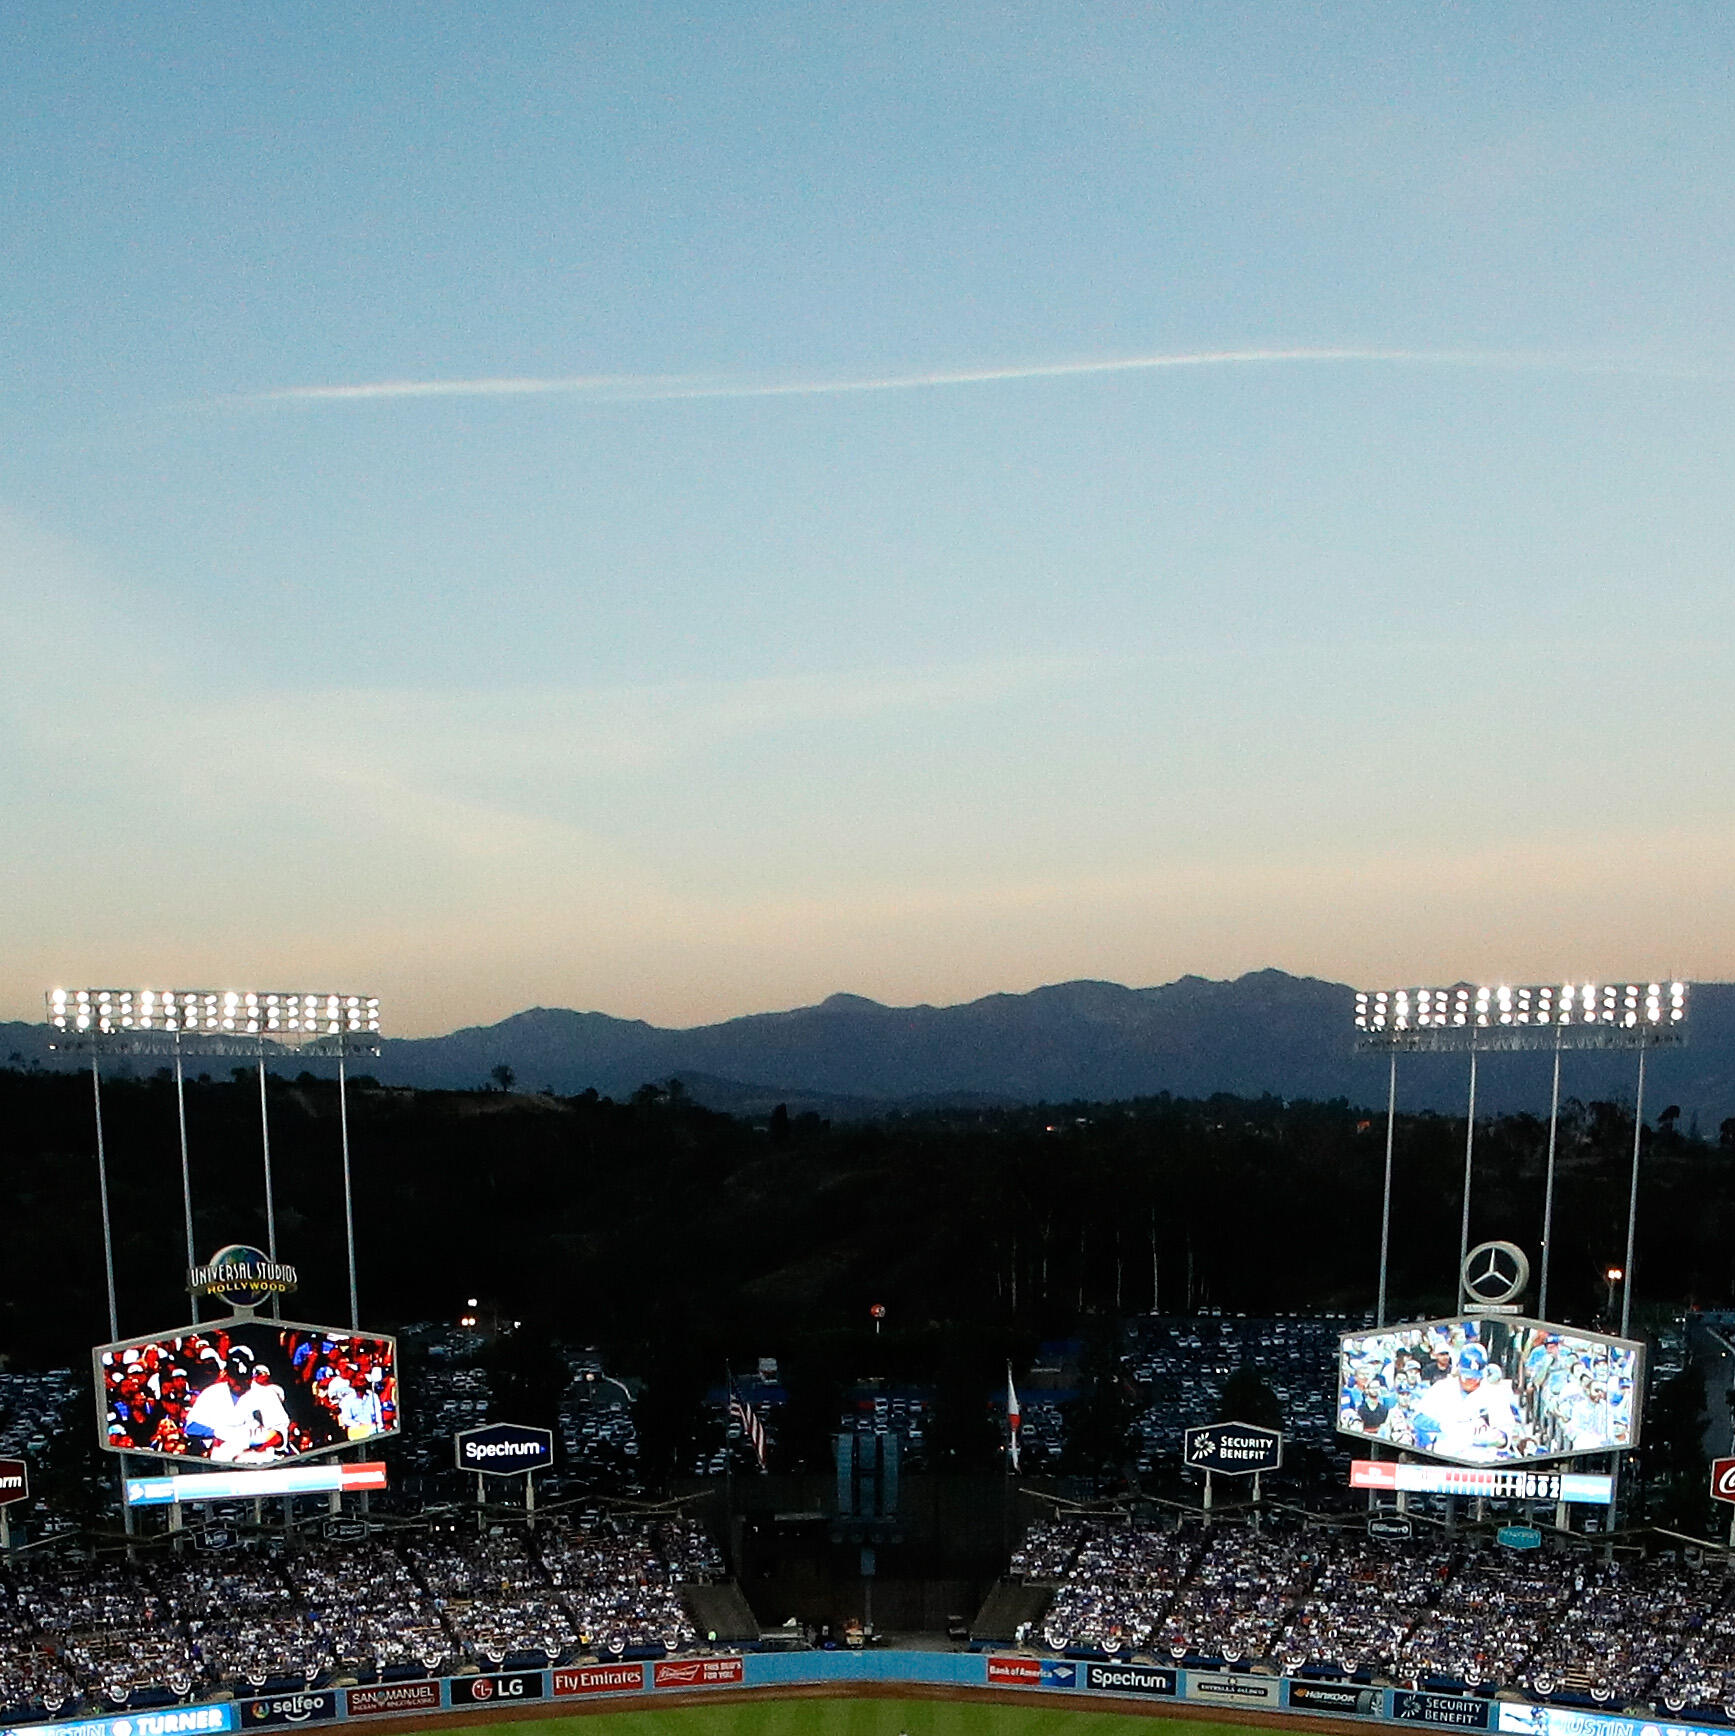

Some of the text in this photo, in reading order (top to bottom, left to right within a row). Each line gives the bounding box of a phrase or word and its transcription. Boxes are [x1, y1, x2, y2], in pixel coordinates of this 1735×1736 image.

[191, 1261, 297, 1287] UNIVERSAL STUDIOS
[206, 1281, 285, 1294] HOLLYWOOD
[465, 1440, 539, 1460] Spectrum
[1220, 1436, 1273, 1448] SECURITY
[1220, 1448, 1266, 1460] BENEFIT
[555, 1675, 578, 1691] Fly
[580, 1671, 641, 1687] Emirates
[1092, 1668, 1167, 1688] Spectrum
[352, 1686, 434, 1705] SAN MANUEL
[497, 1679, 523, 1697] LG
[1425, 1697, 1482, 1714] SECURITY
[136, 1708, 223, 1736] TURNER
[1424, 1709, 1474, 1725] BENEFIT
